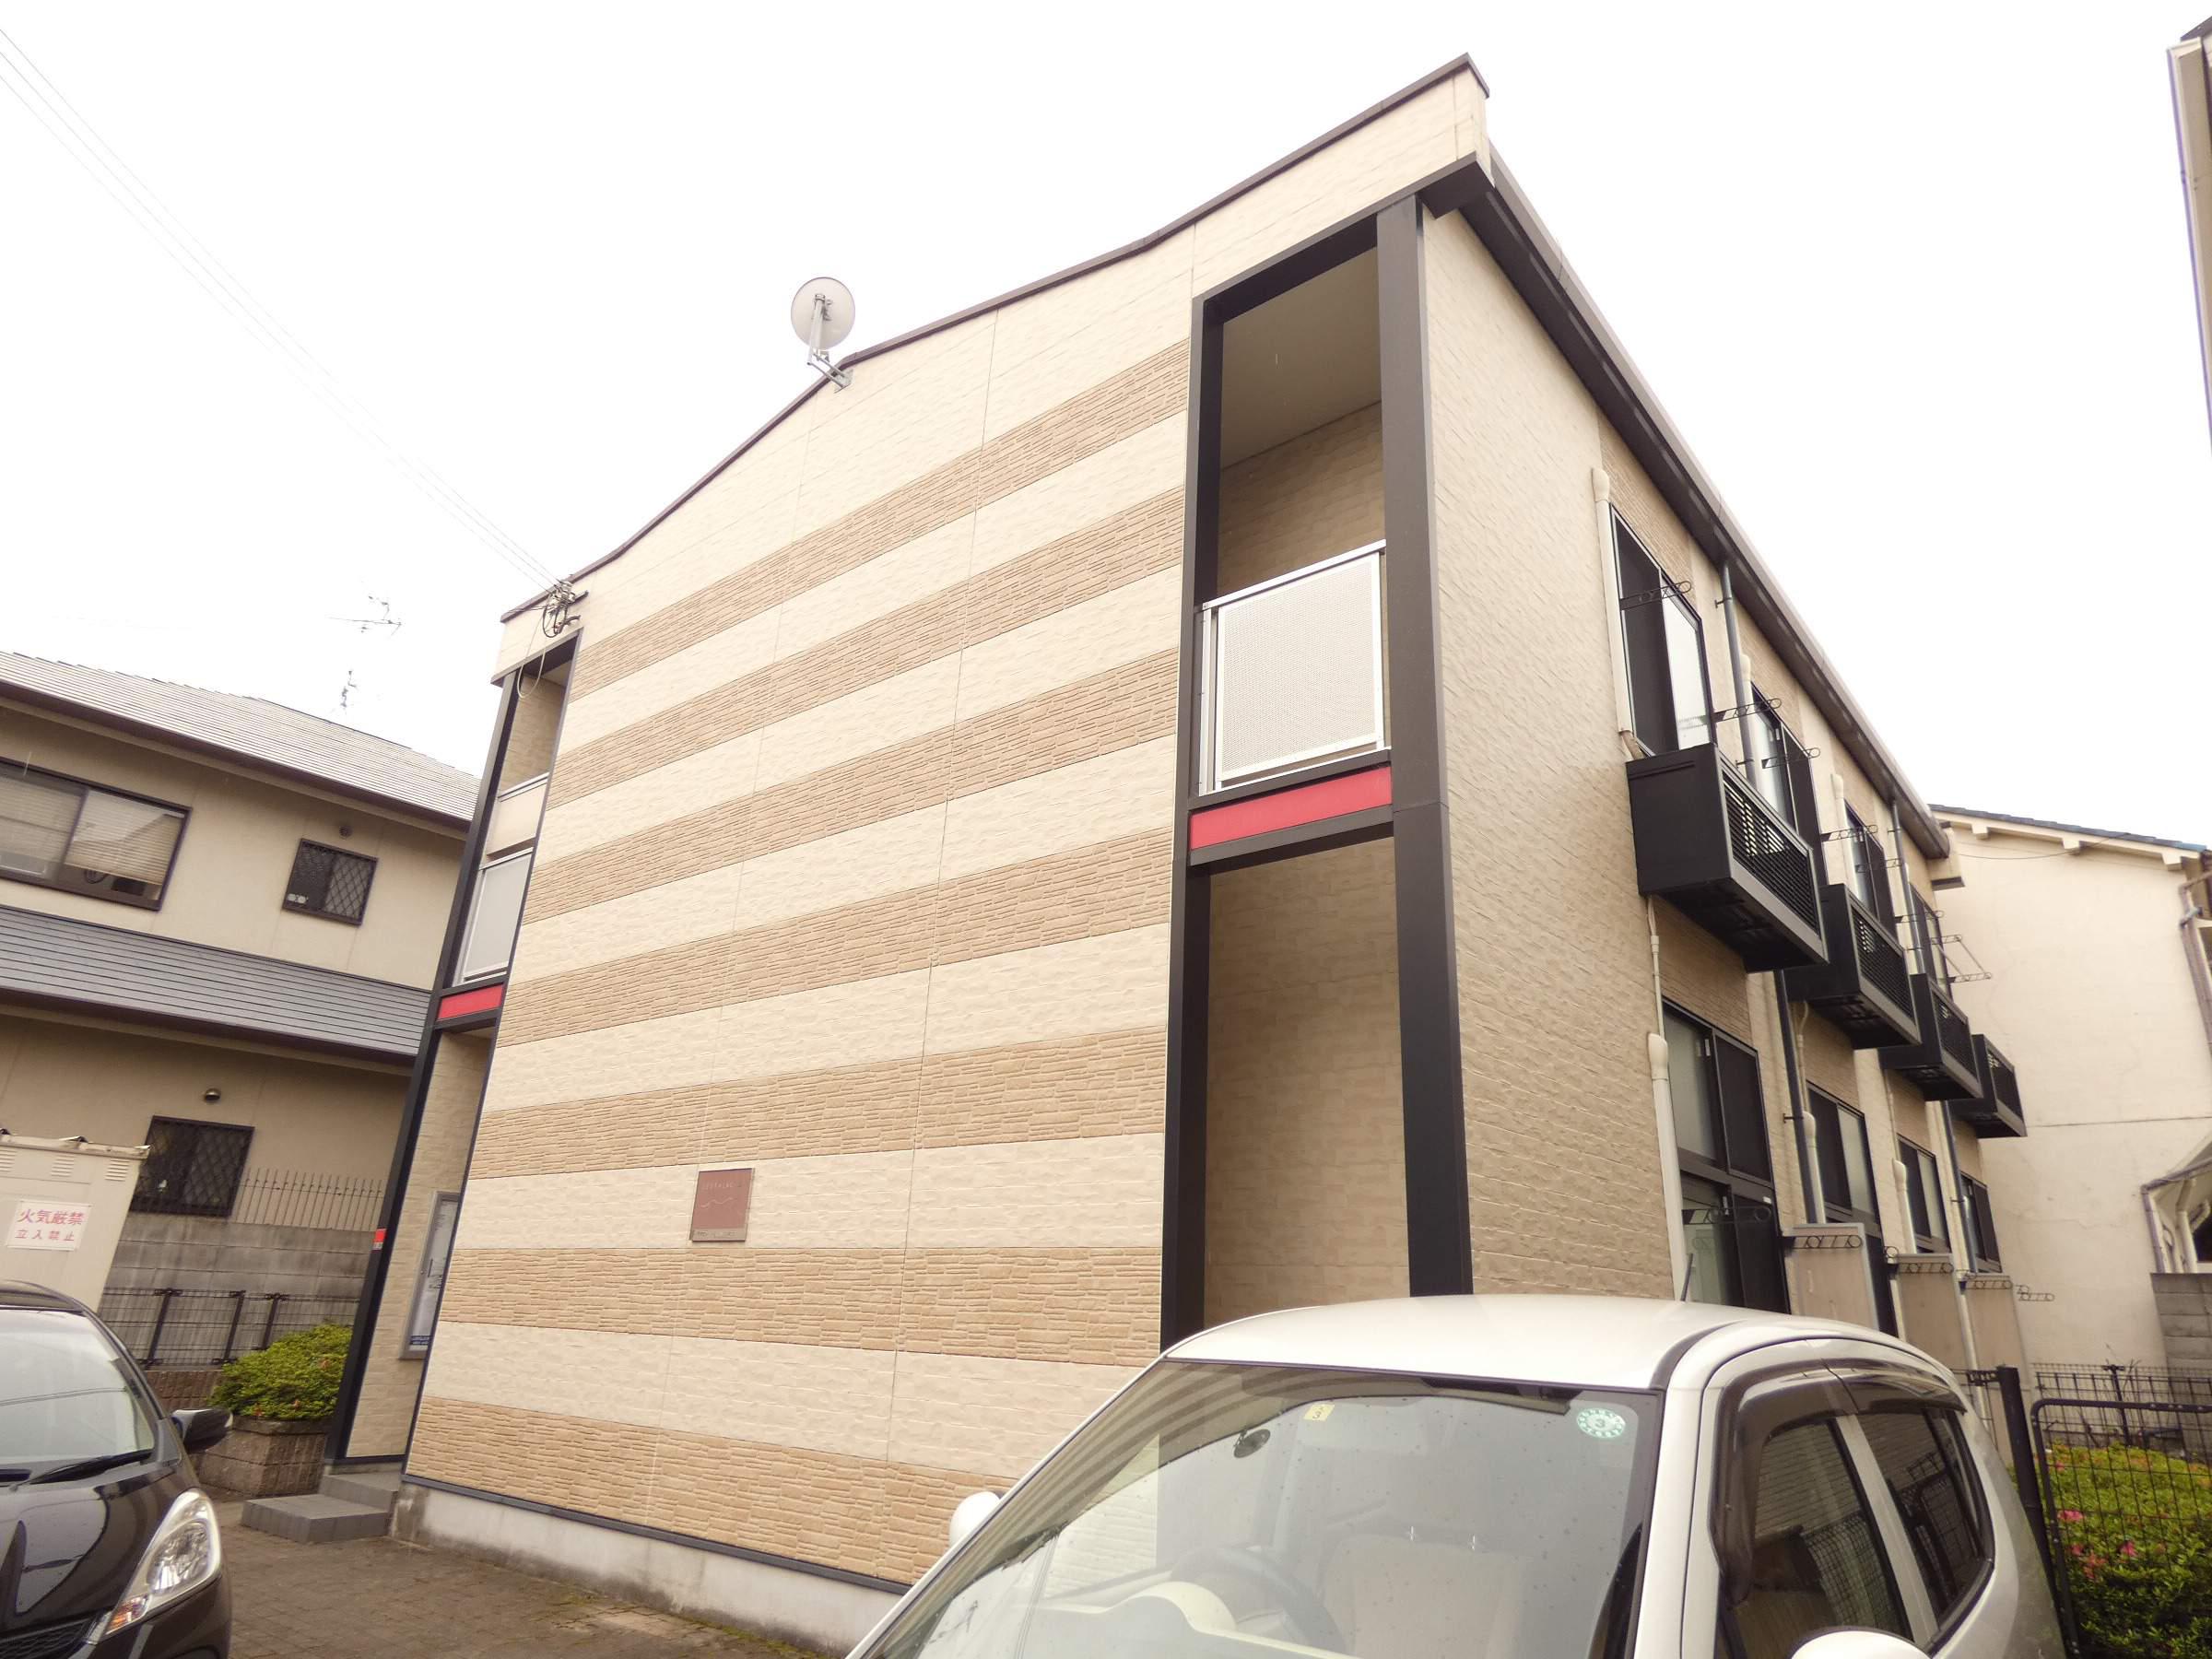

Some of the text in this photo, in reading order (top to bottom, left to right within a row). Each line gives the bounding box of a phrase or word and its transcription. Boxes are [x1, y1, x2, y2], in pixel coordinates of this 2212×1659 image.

[17, 1208, 84, 1225] 火気厳禁
[15, 1230, 75, 1241] 立入禁止
